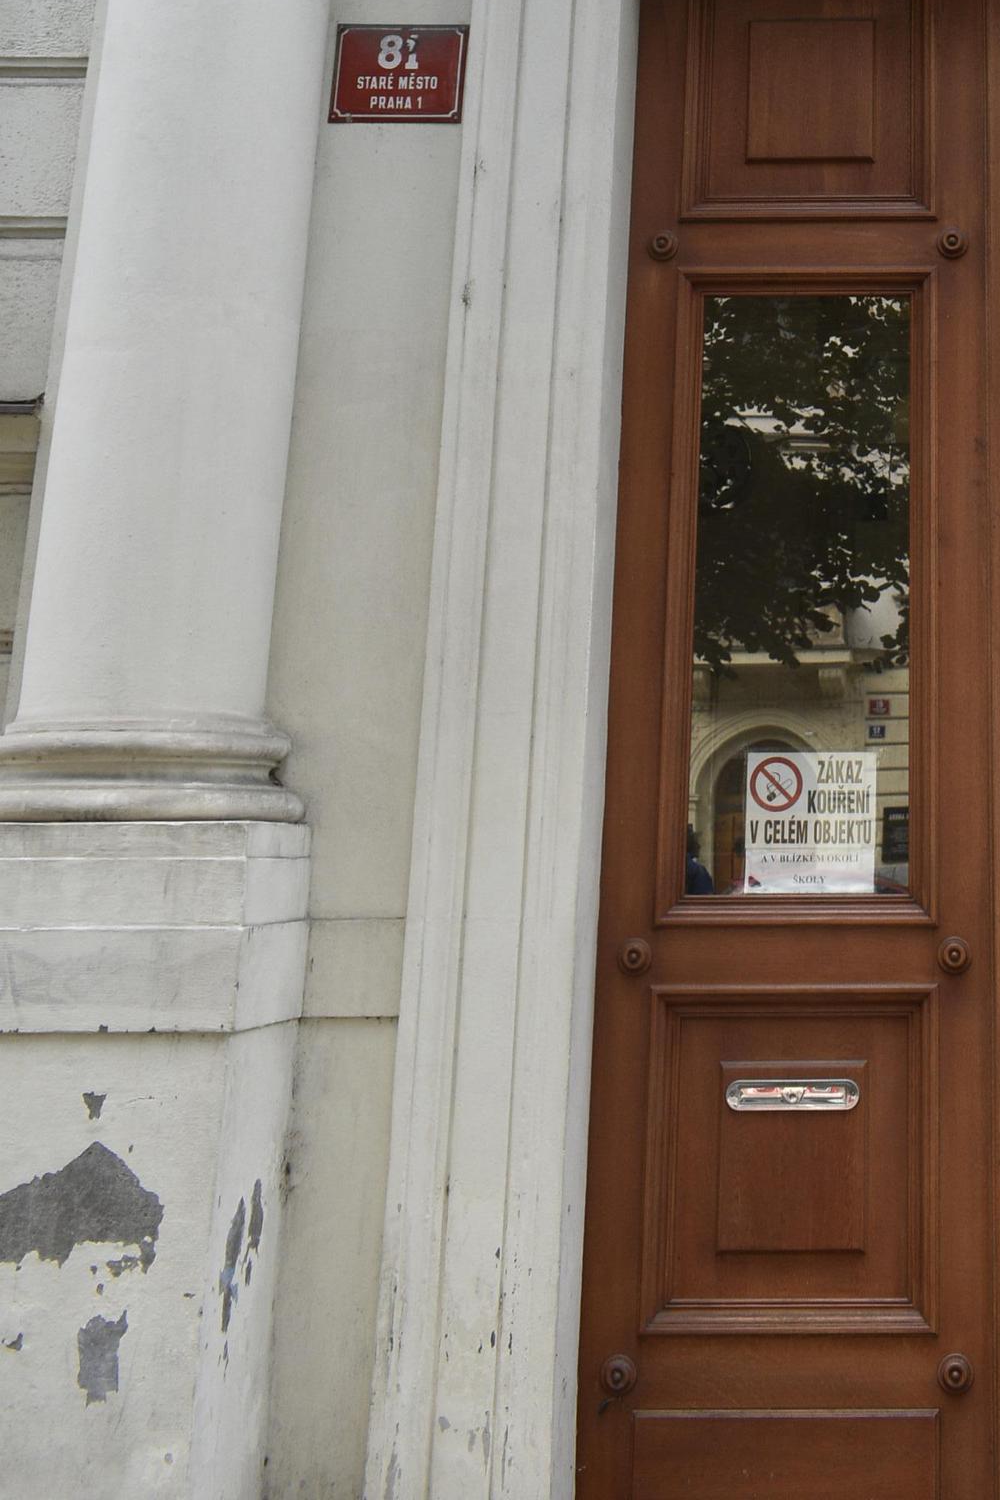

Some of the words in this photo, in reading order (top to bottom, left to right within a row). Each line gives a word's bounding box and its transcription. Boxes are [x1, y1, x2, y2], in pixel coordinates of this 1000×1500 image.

[356, 73, 394, 90] STARÉ
[398, 73, 438, 90] MĚSTO
[370, 96, 412, 109] PRAHA
[417, 96, 422, 109] 1
[816, 755, 863, 784] ZÁKAZ
[807, 785, 871, 814] KOUŘENÍ
[750, 820, 759, 844] V
[764, 815, 808, 844] CELÉM
[814, 820, 872, 844] OBJEKTU
[760, 855, 768, 864] A
[770, 855, 777, 863] V
[779, 853, 826, 863] BLÍZKÉM
[827, 852, 860, 863] OKOLÍ
[792, 873, 827, 885] ŠKOLY
